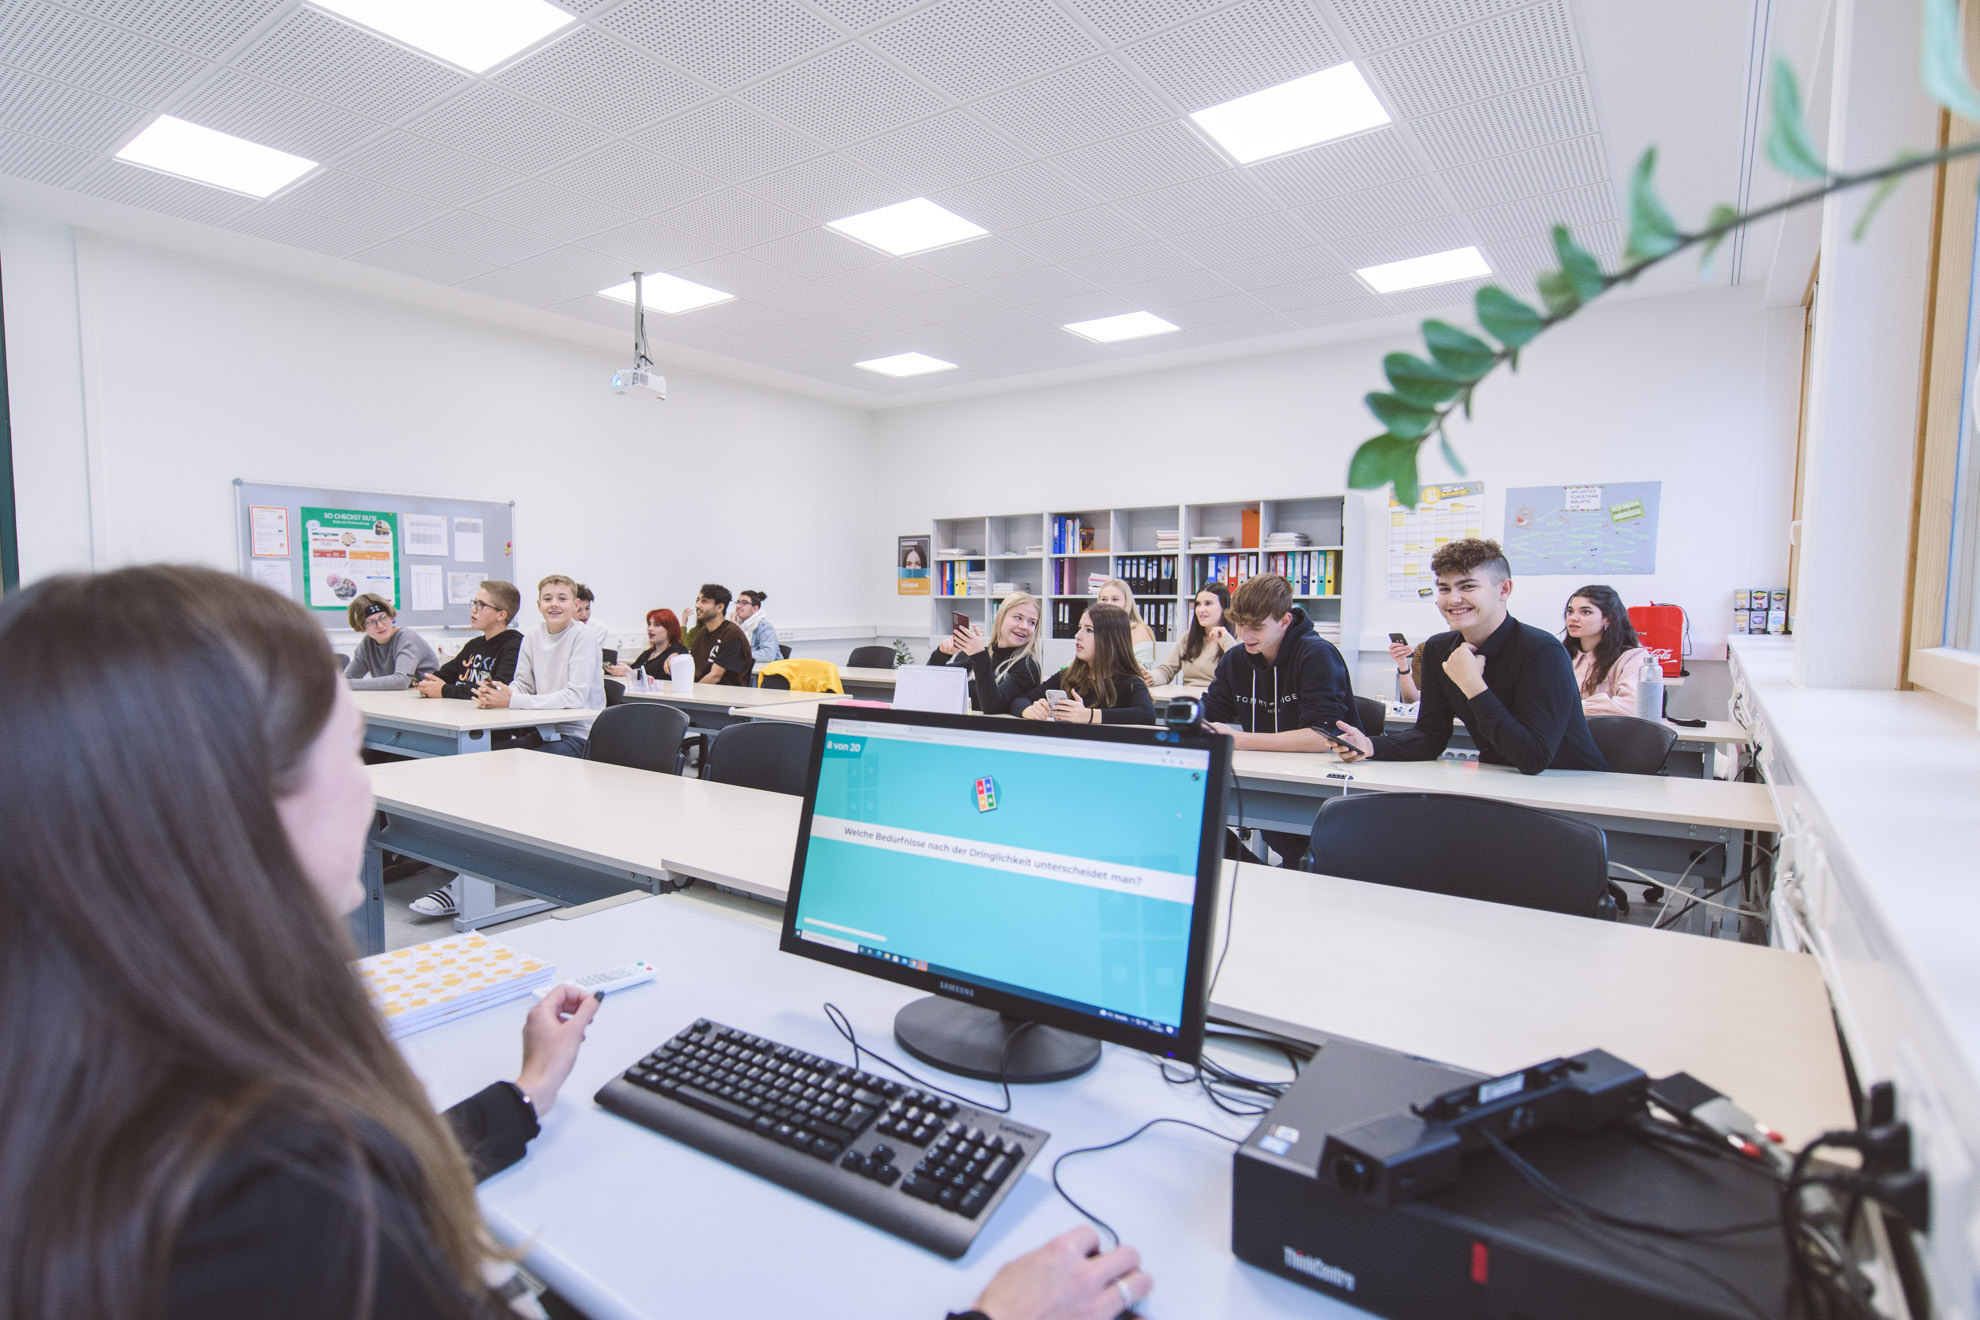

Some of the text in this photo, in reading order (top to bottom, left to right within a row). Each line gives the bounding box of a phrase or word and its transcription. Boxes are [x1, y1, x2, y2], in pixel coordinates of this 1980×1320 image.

[323, 512, 334, 520] SO
[334, 513, 361, 521] CHECKST
[833, 742, 849, 752] von
[849, 742, 861, 753] 20
[844, 826, 1142, 887] Welche Bedürfnisse nach der Dringlichkeit unterscheidet man?
[939, 981, 974, 998] SAMSUNG
[1283, 1245, 1356, 1292] ThinkCentre
